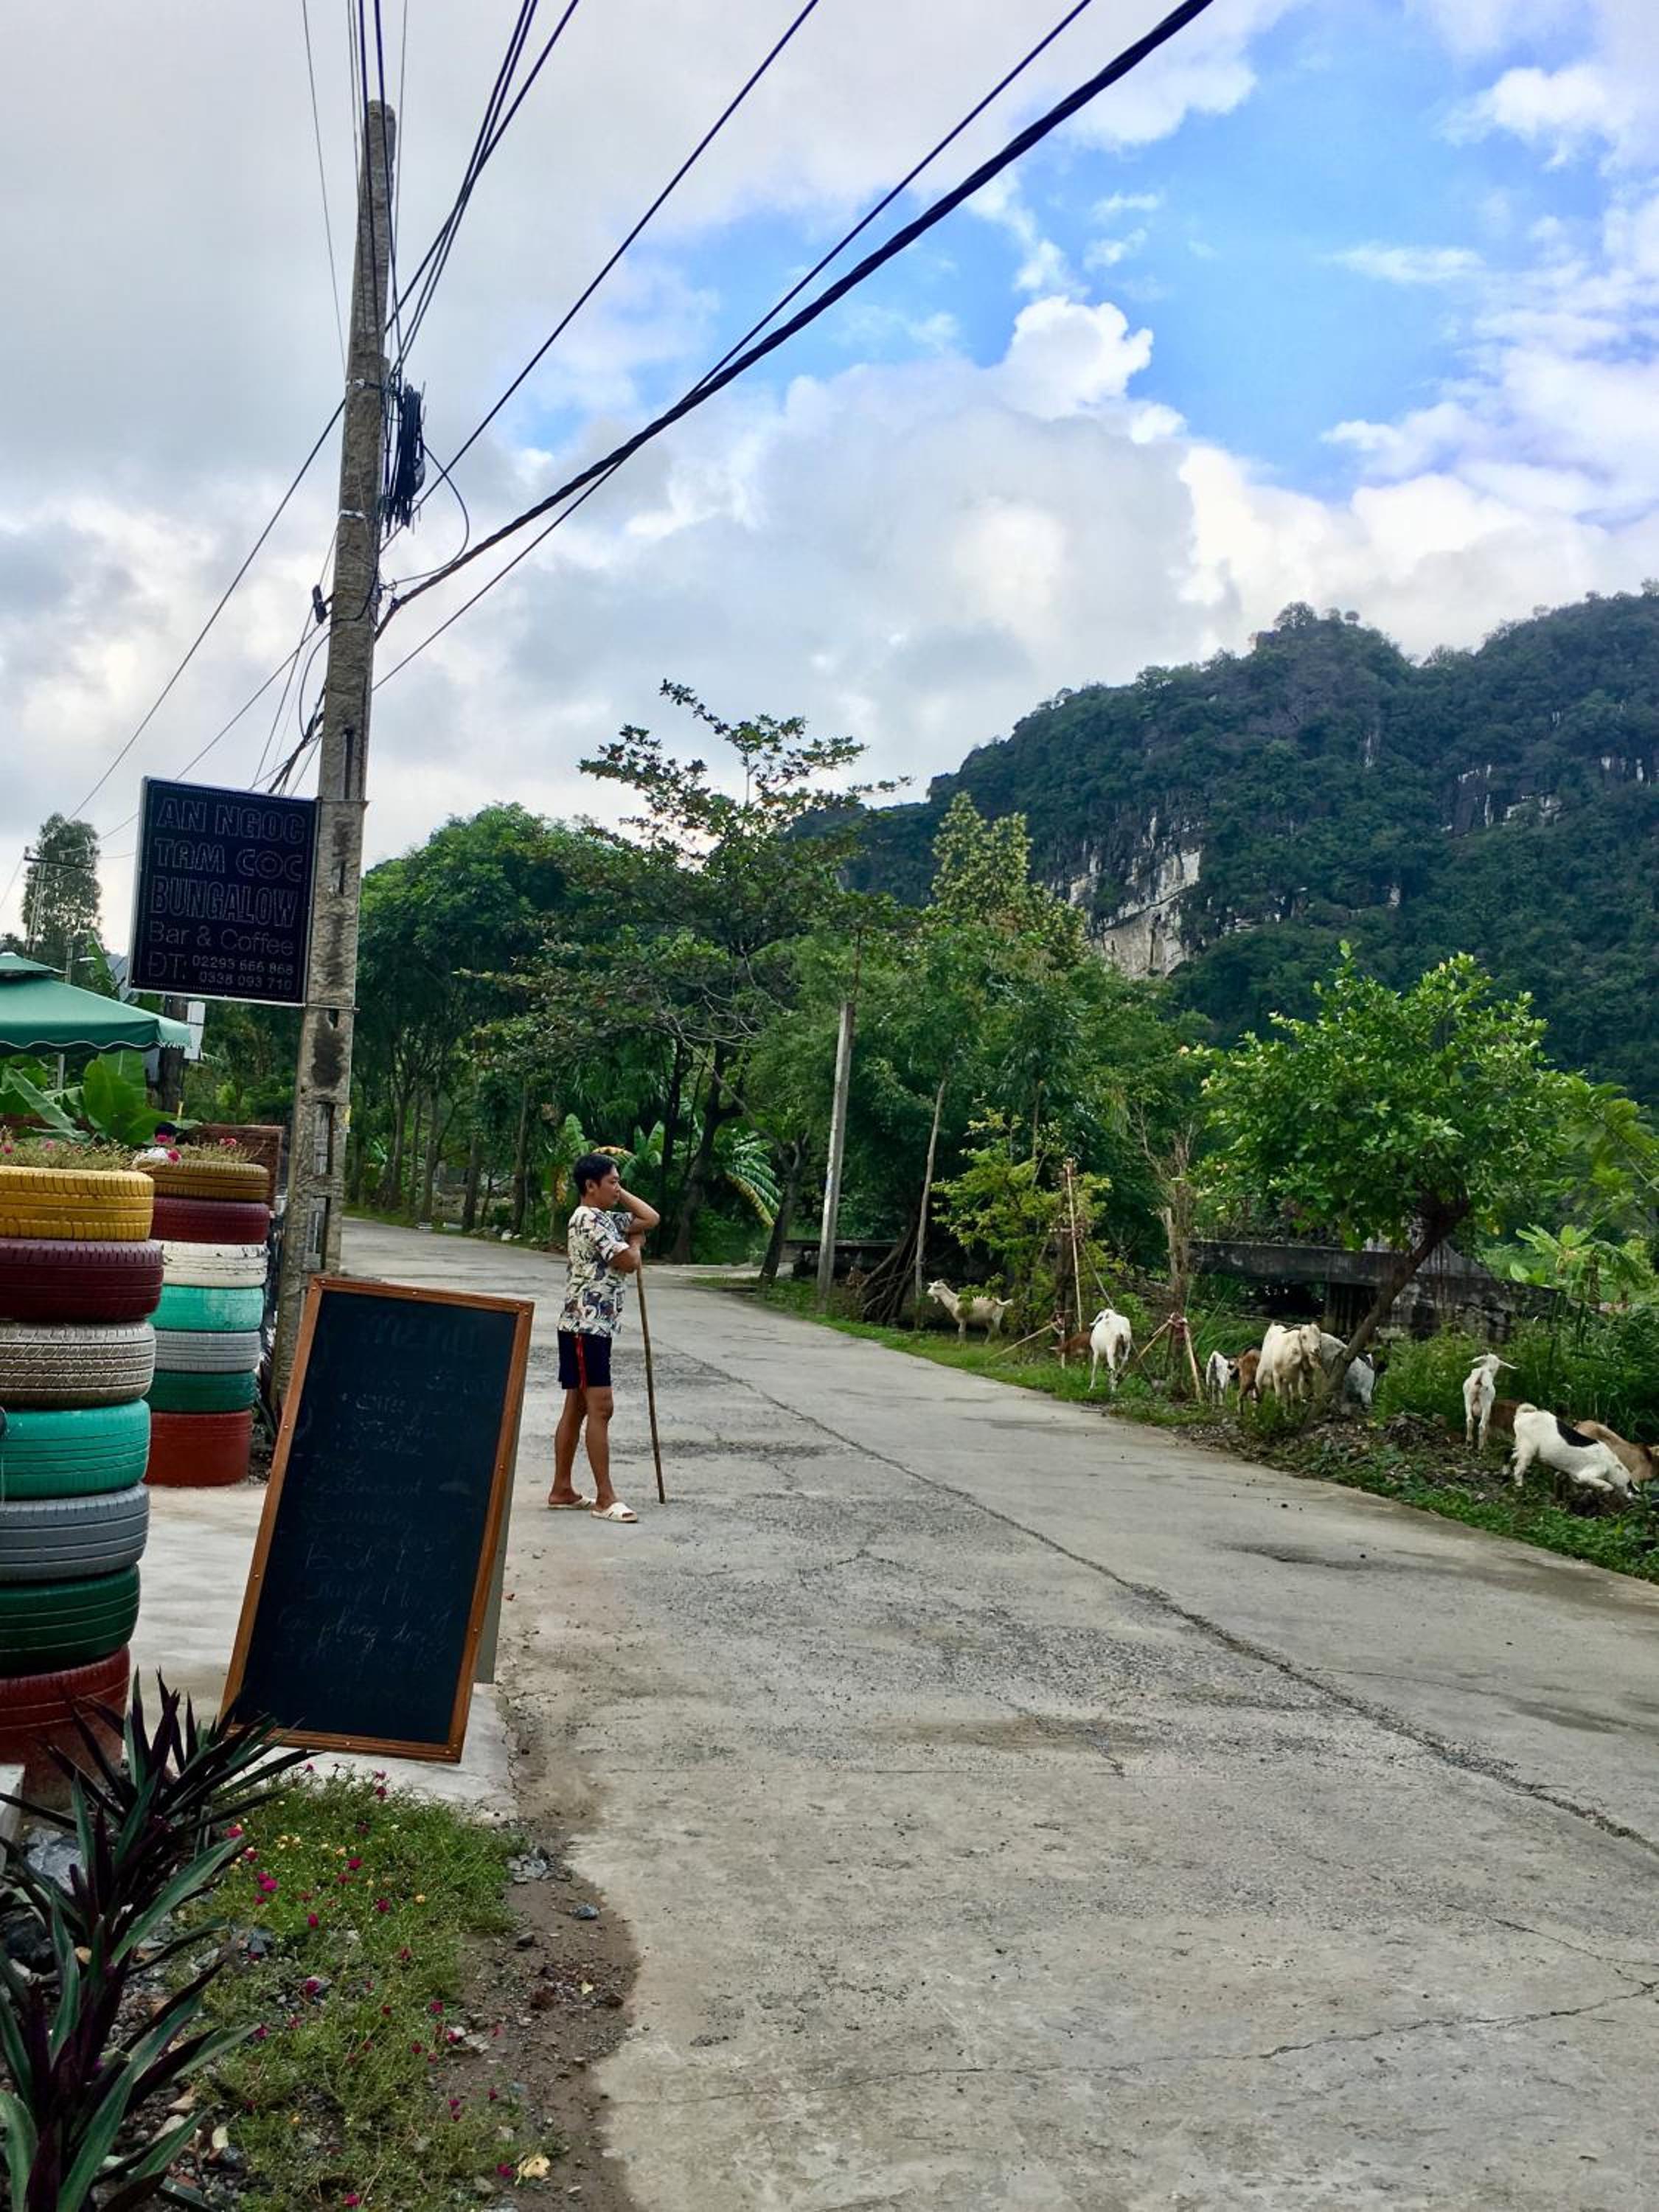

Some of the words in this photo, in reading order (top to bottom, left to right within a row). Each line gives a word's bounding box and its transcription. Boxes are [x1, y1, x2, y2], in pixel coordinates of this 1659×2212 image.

[156, 797, 207, 832] AN
[215, 804, 305, 844] NGOC
[236, 849, 303, 883] COC
[151, 875, 299, 928] BUNGALOW
[149, 920, 189, 944] Bar
[197, 925, 212, 947] &
[220, 928, 293, 956] Coffee
